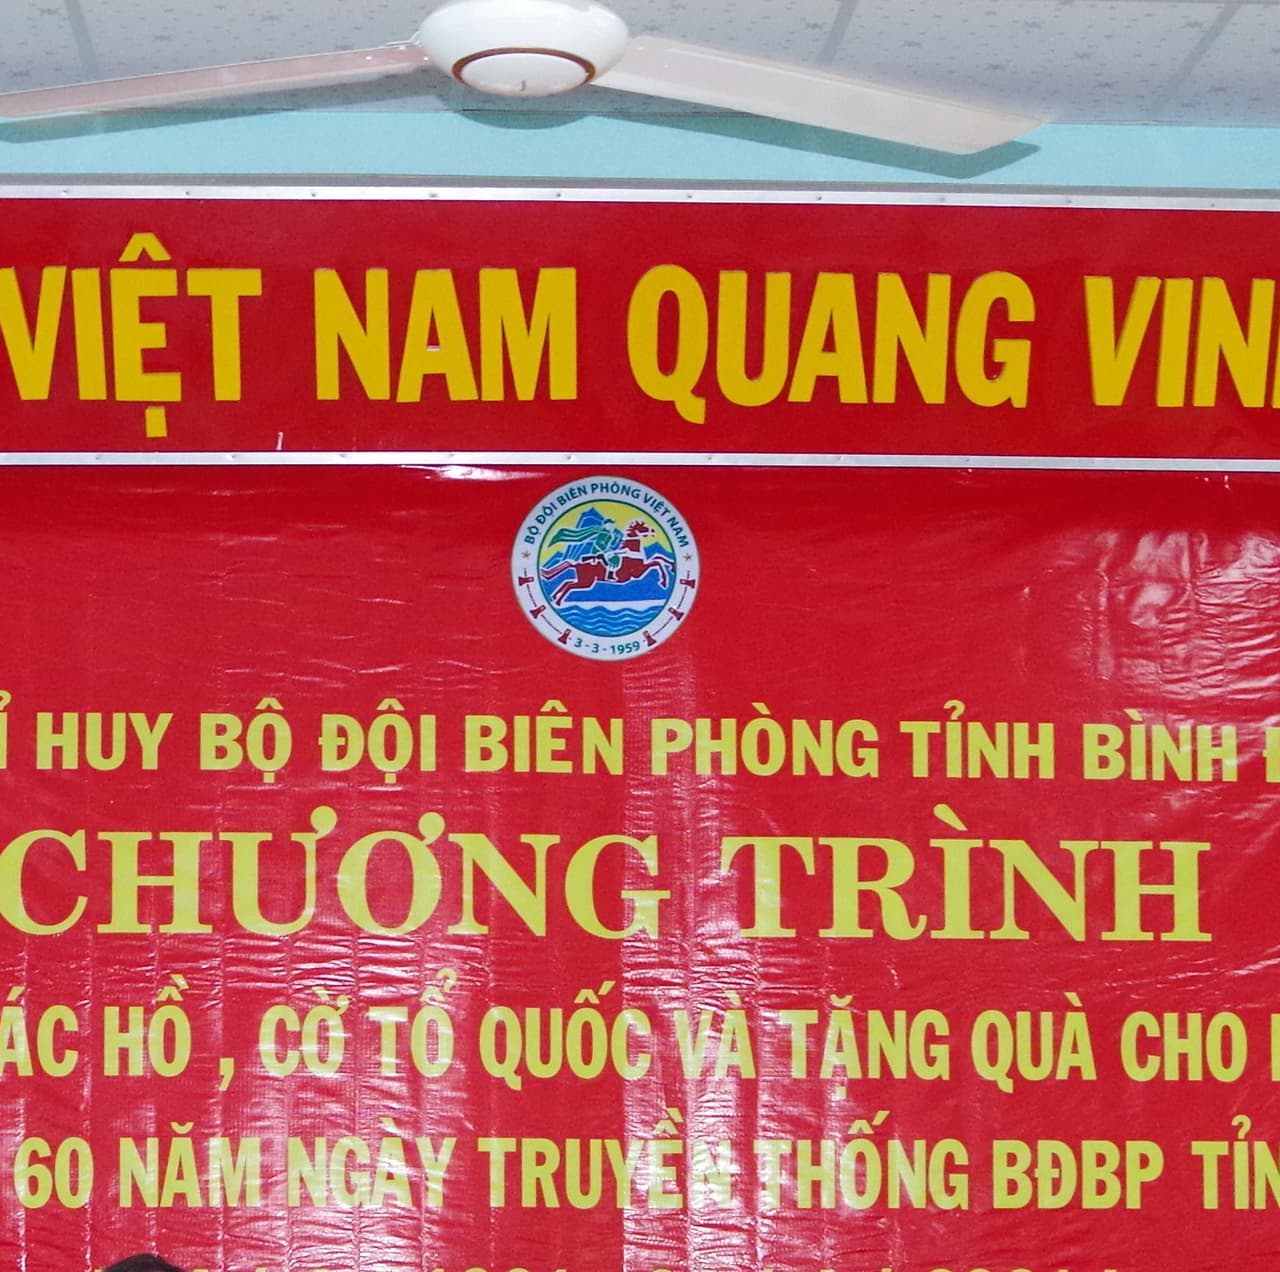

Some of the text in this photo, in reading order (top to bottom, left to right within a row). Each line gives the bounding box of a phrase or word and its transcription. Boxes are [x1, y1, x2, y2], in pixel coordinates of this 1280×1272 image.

[313, 265, 577, 404] NAM
[626, 264, 1036, 424] QUANG
[524, 480, 690, 548] BỘ ĐỘI BIÊN PHÒNG VIỆT NAM
[36, 711, 173, 772] HUY
[199, 697, 292, 783] BỘ
[318, 699, 437, 784] ĐỘI
[463, 700, 624, 776] BIÊN
[651, 702, 879, 778] PHÒNG
[899, 699, 1055, 780] TỈNH
[1082, 709, 1238, 783] BÌNH
[719, 803, 1213, 943] TRÌNH
[103, 973, 193, 1077] HỒ
[258, 986, 351, 1078] CỜ
[367, 967, 458, 1078] TỔ
[478, 980, 652, 1092] QUỐC
[672, 989, 756, 1080] VÀ
[776, 994, 951, 1102] TẶNG
[970, 990, 1098, 1094] QUÀ
[1120, 1010, 1249, 1084] CHO
[13, 1136, 94, 1209] 60
[118, 1121, 261, 1209] NĂM
[287, 1117, 458, 1209] NGÀY
[477, 1107, 736, 1210] TRUYỀN
[753, 1109, 970, 1210] THỐNG
[991, 1138, 1165, 1210] BĐBP
